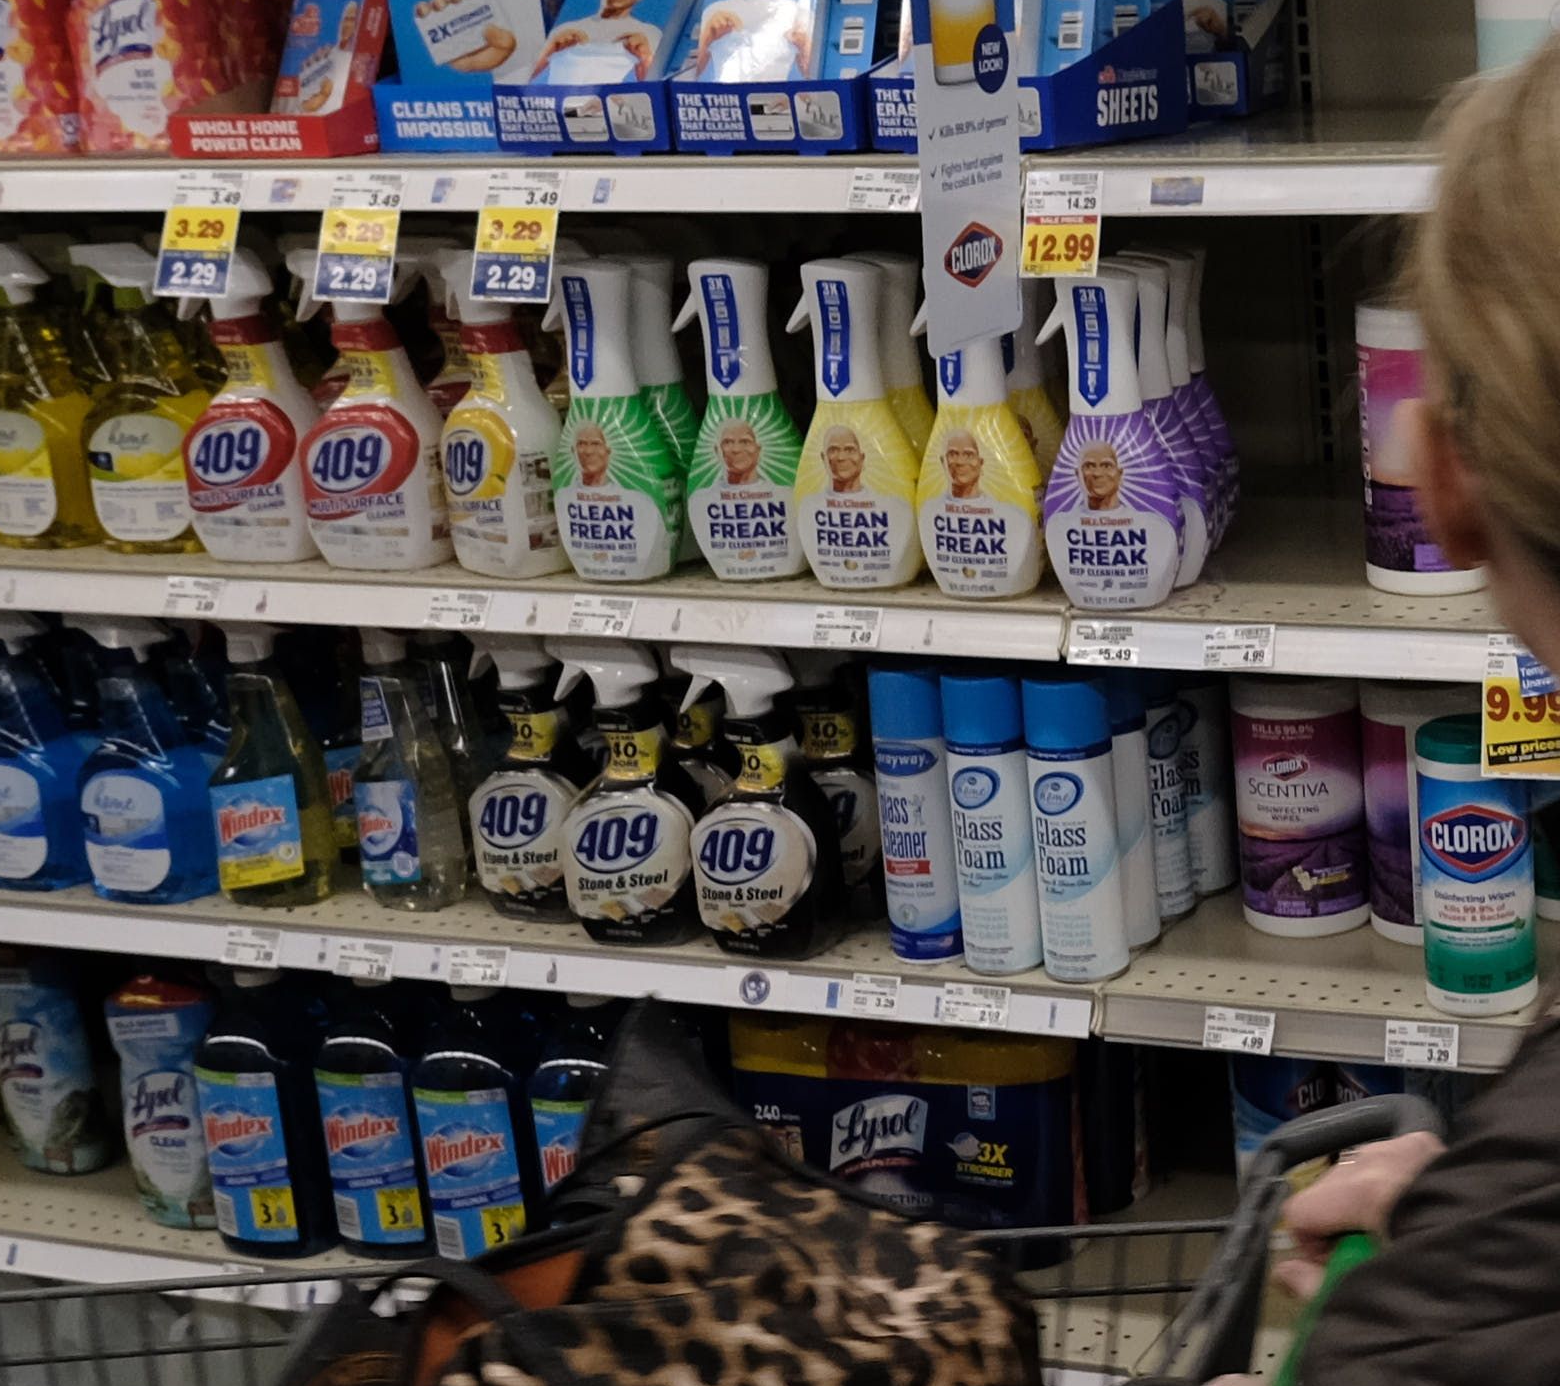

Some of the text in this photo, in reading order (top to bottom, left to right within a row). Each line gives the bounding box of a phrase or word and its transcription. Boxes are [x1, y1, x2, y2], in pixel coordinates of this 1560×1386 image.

[981, 42, 1001, 56] NEW
[979, 56, 1003, 73] LOOK!
[676, 93, 740, 110] THE THIN
[1097, 86, 1159, 125] SHEETS
[678, 106, 741, 122] ERASER
[189, 119, 299, 136] WHOLE HOME
[174, 220, 225, 239] 3.29
[488, 220, 543, 242] 3.29
[1027, 233, 1095, 261] 12.99
[170, 263, 216, 287] 2.29
[328, 265, 377, 292] 2.29
[194, 427, 261, 474] 409
[567, 504, 635, 523] CLEAN
[709, 501, 787, 522] CLEAN
[814, 509, 889, 529] CLEAN
[569, 522, 635, 541] FREAK
[710, 518, 788, 540] FREAK
[816, 528, 890, 548] FREAK
[1489, 743, 1517, 757] Low
[576, 814, 658, 862] 409
[1036, 818, 1086, 846] Glass
[1431, 821, 1516, 853] CLOROX
[700, 827, 775, 872] 409
[578, 870, 669, 890] Stone & Steel
[424, 1131, 506, 1175] Windex
